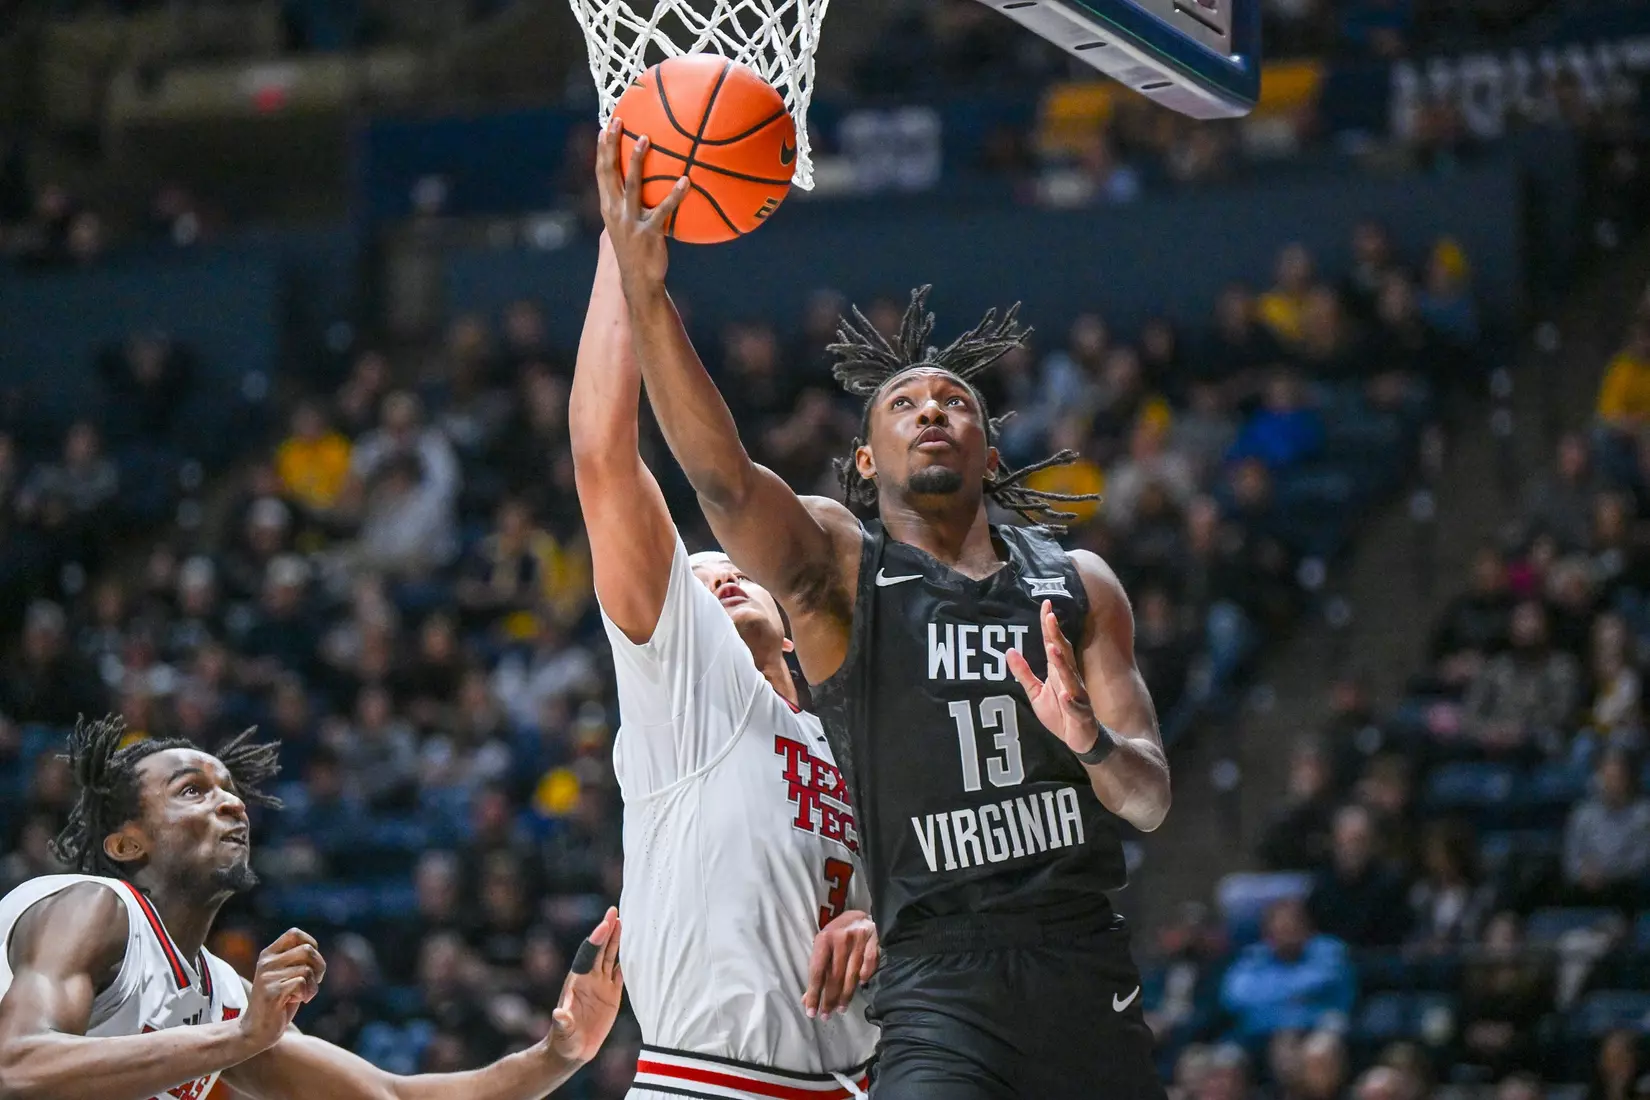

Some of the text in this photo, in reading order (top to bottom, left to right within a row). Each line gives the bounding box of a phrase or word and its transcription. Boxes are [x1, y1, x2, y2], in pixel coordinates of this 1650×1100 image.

[928, 622, 1029, 681] WEST
[948, 694, 1025, 792] 13
[911, 786, 1085, 872] VIRGINIA
[818, 856, 855, 931] 3
